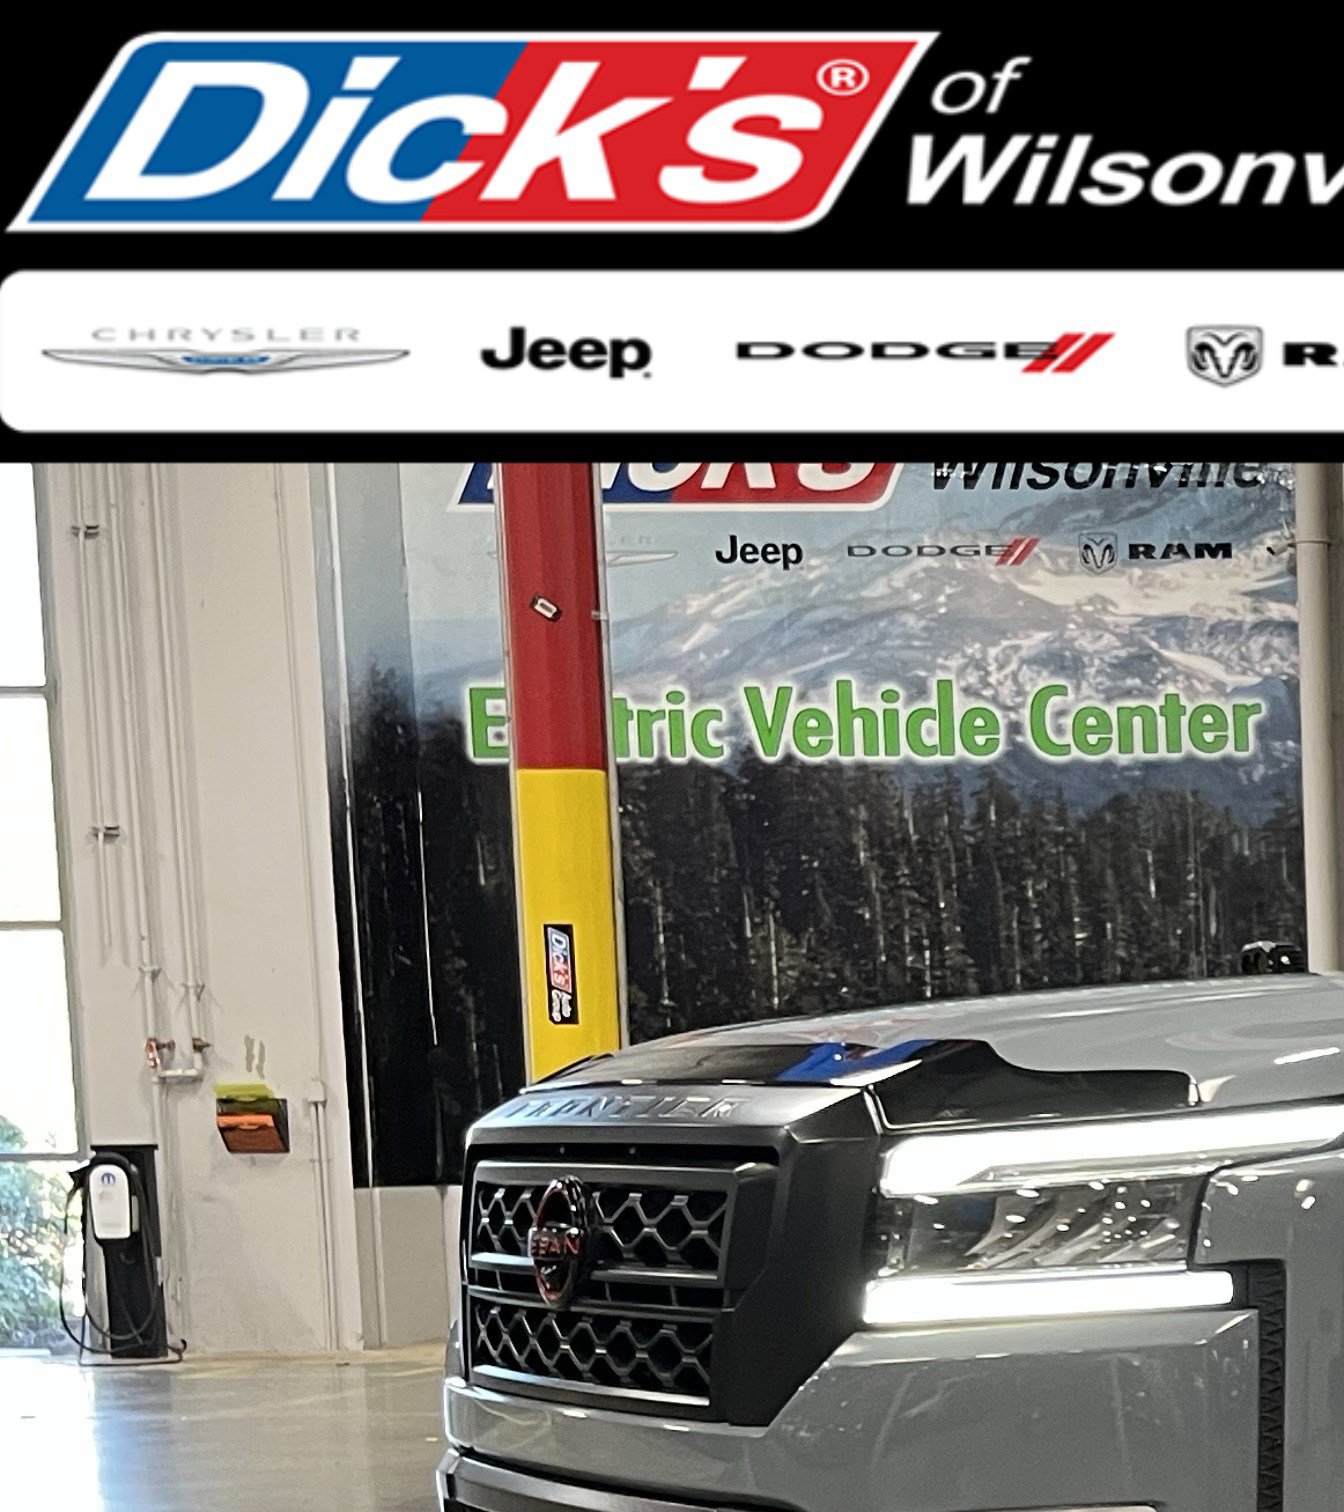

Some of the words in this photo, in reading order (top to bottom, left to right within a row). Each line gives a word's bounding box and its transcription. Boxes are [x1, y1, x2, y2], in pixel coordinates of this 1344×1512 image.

[715, 535, 804, 570] Jeep
[847, 543, 1012, 558] DODGE
[1127, 542, 1233, 561] RAM
[469, 687, 725, 759] Etric
[743, 679, 1001, 759] Vehicle
[1029, 684, 1264, 757] Center
